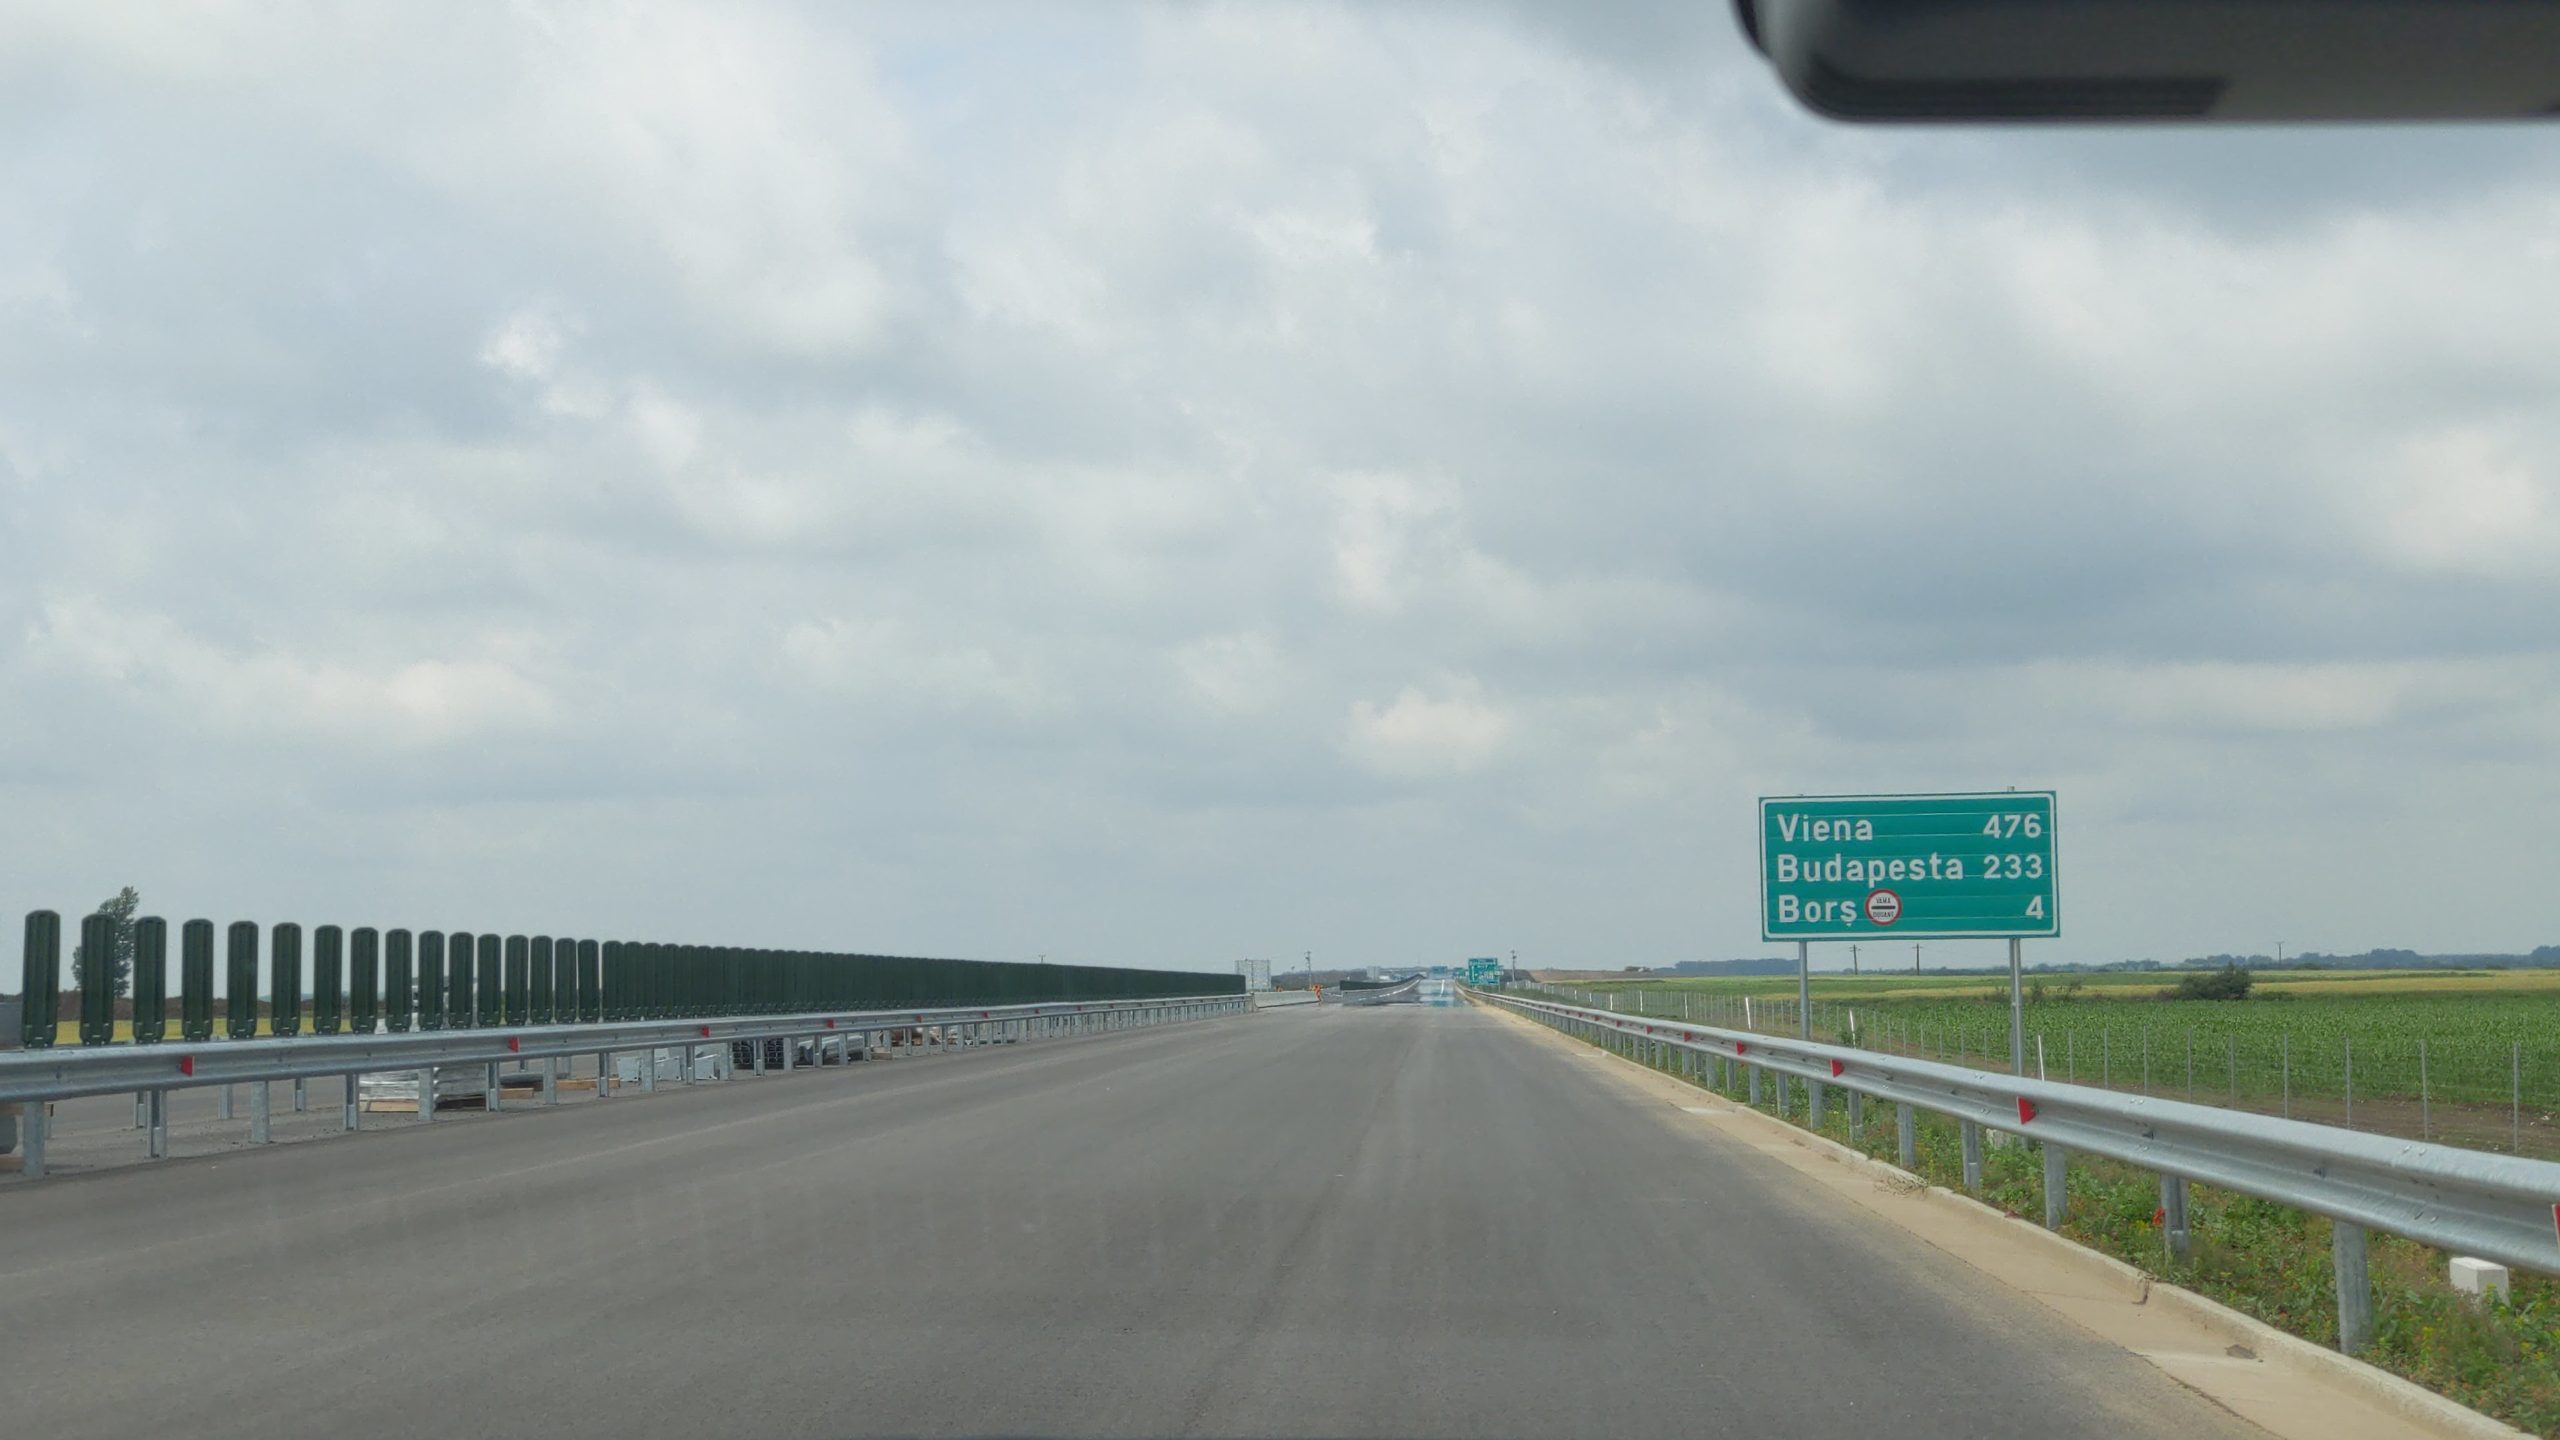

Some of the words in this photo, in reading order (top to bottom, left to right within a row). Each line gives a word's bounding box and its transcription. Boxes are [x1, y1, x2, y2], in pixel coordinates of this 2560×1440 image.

[1777, 813, 1873, 842] Viena
[1983, 813, 2042, 838] 476
[1778, 853, 1964, 888] Budapesta
[1984, 854, 2043, 879] 233
[1778, 894, 1857, 926] Borș
[2025, 895, 2044, 919] 4
